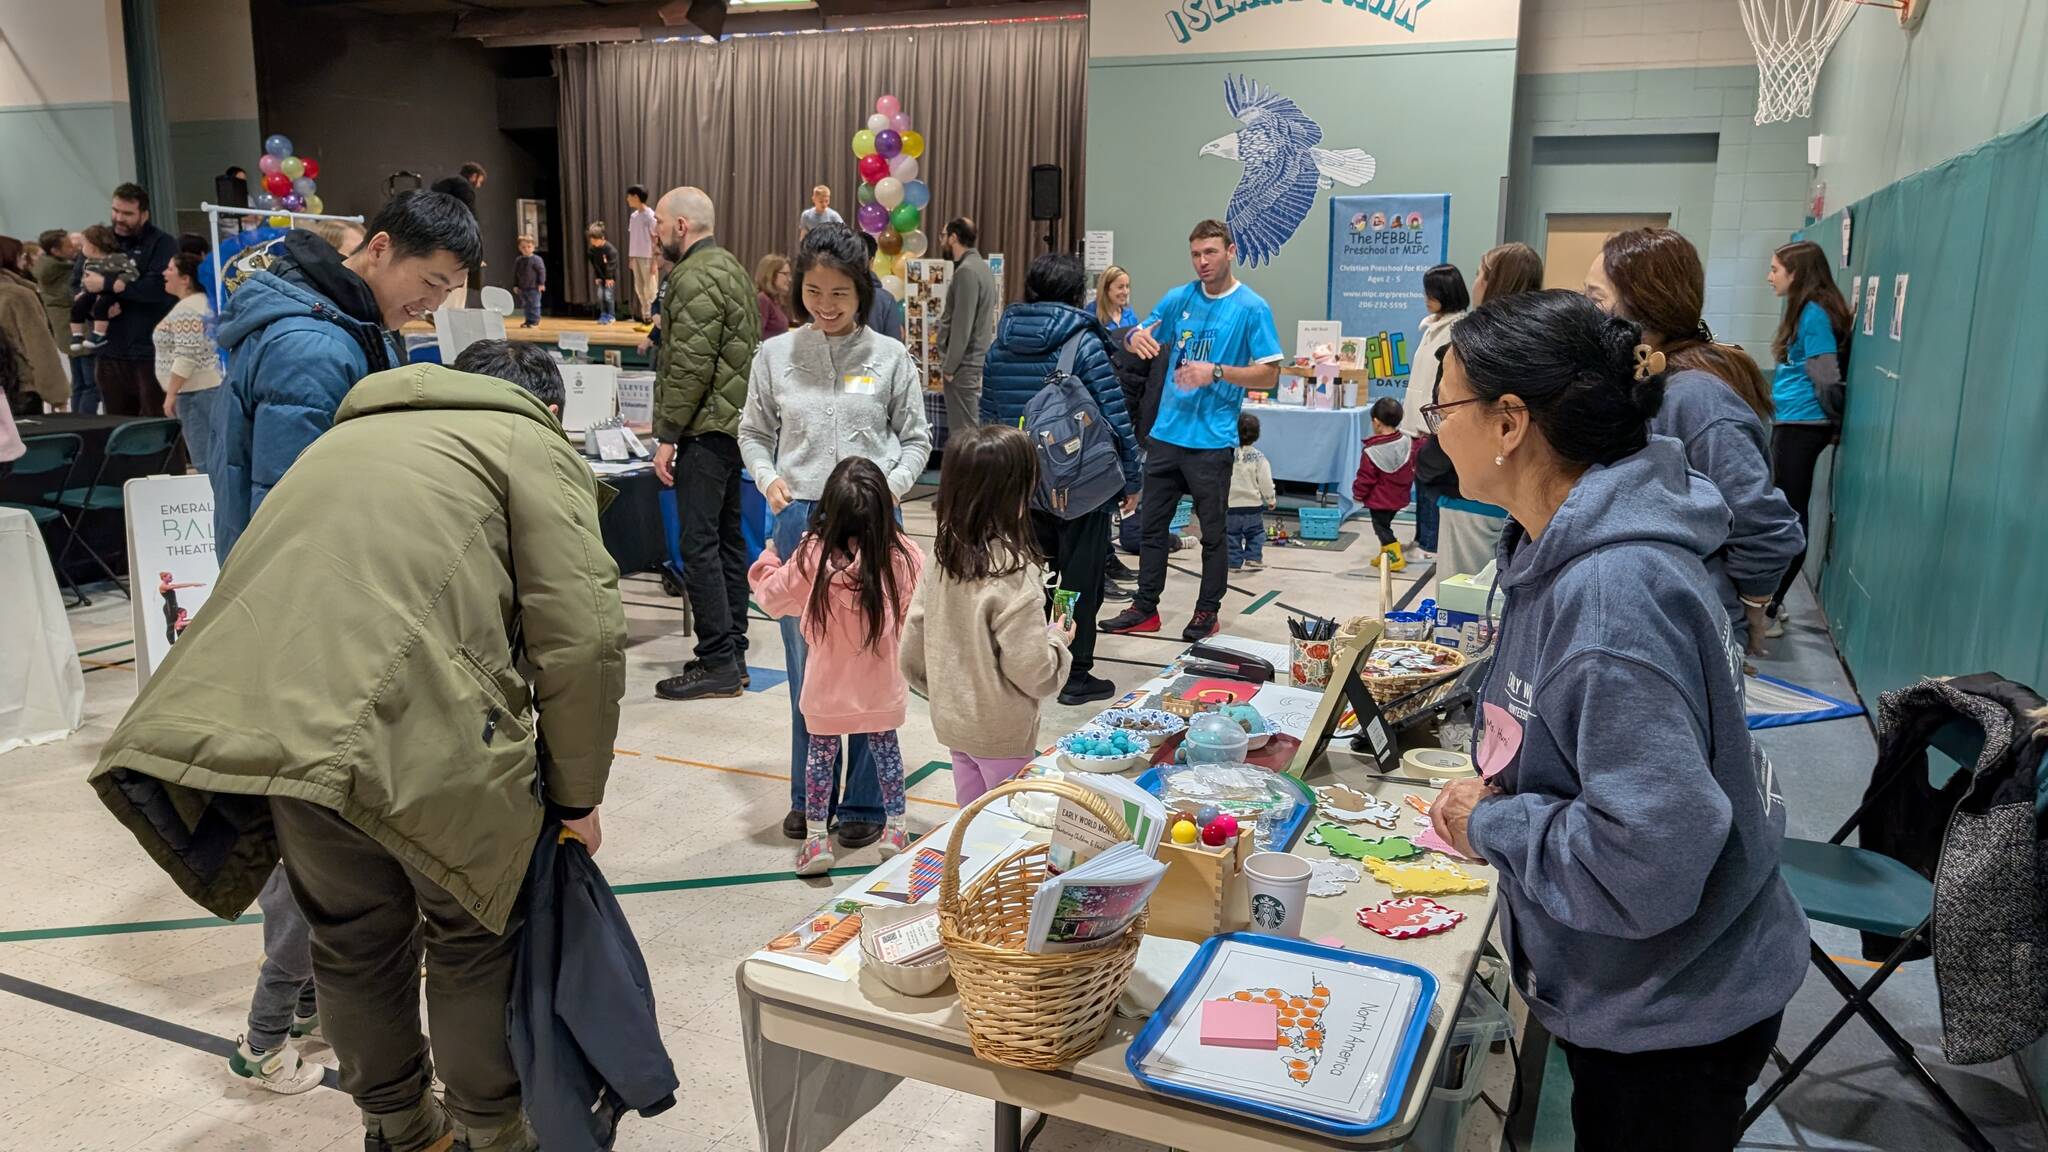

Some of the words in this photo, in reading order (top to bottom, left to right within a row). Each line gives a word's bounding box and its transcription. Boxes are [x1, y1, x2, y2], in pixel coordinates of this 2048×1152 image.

[1349, 232, 1372, 245] The
[1374, 231, 1423, 245] PEBBLE
[1344, 245, 1387, 256] Preschool
[1390, 246, 1399, 254] at
[1402, 245, 1430, 254] MIPC
[1339, 264, 1369, 272] Christian
[1371, 264, 1403, 272] Preschool
[1404, 264, 1414, 272] for
[1367, 275, 1385, 284] Ages
[1343, 291, 1425, 299] www.mipc.org/preschoo
[160, 501, 215, 515] EMERAL
[162, 518, 215, 541] BAL
[165, 543, 216, 556] THEATR
[1062, 808, 1079, 821] EARLY
[1079, 815, 1098, 829] WORLD
[1350, 1002, 1381, 1033] North
[1330, 1034, 1366, 1077] America
